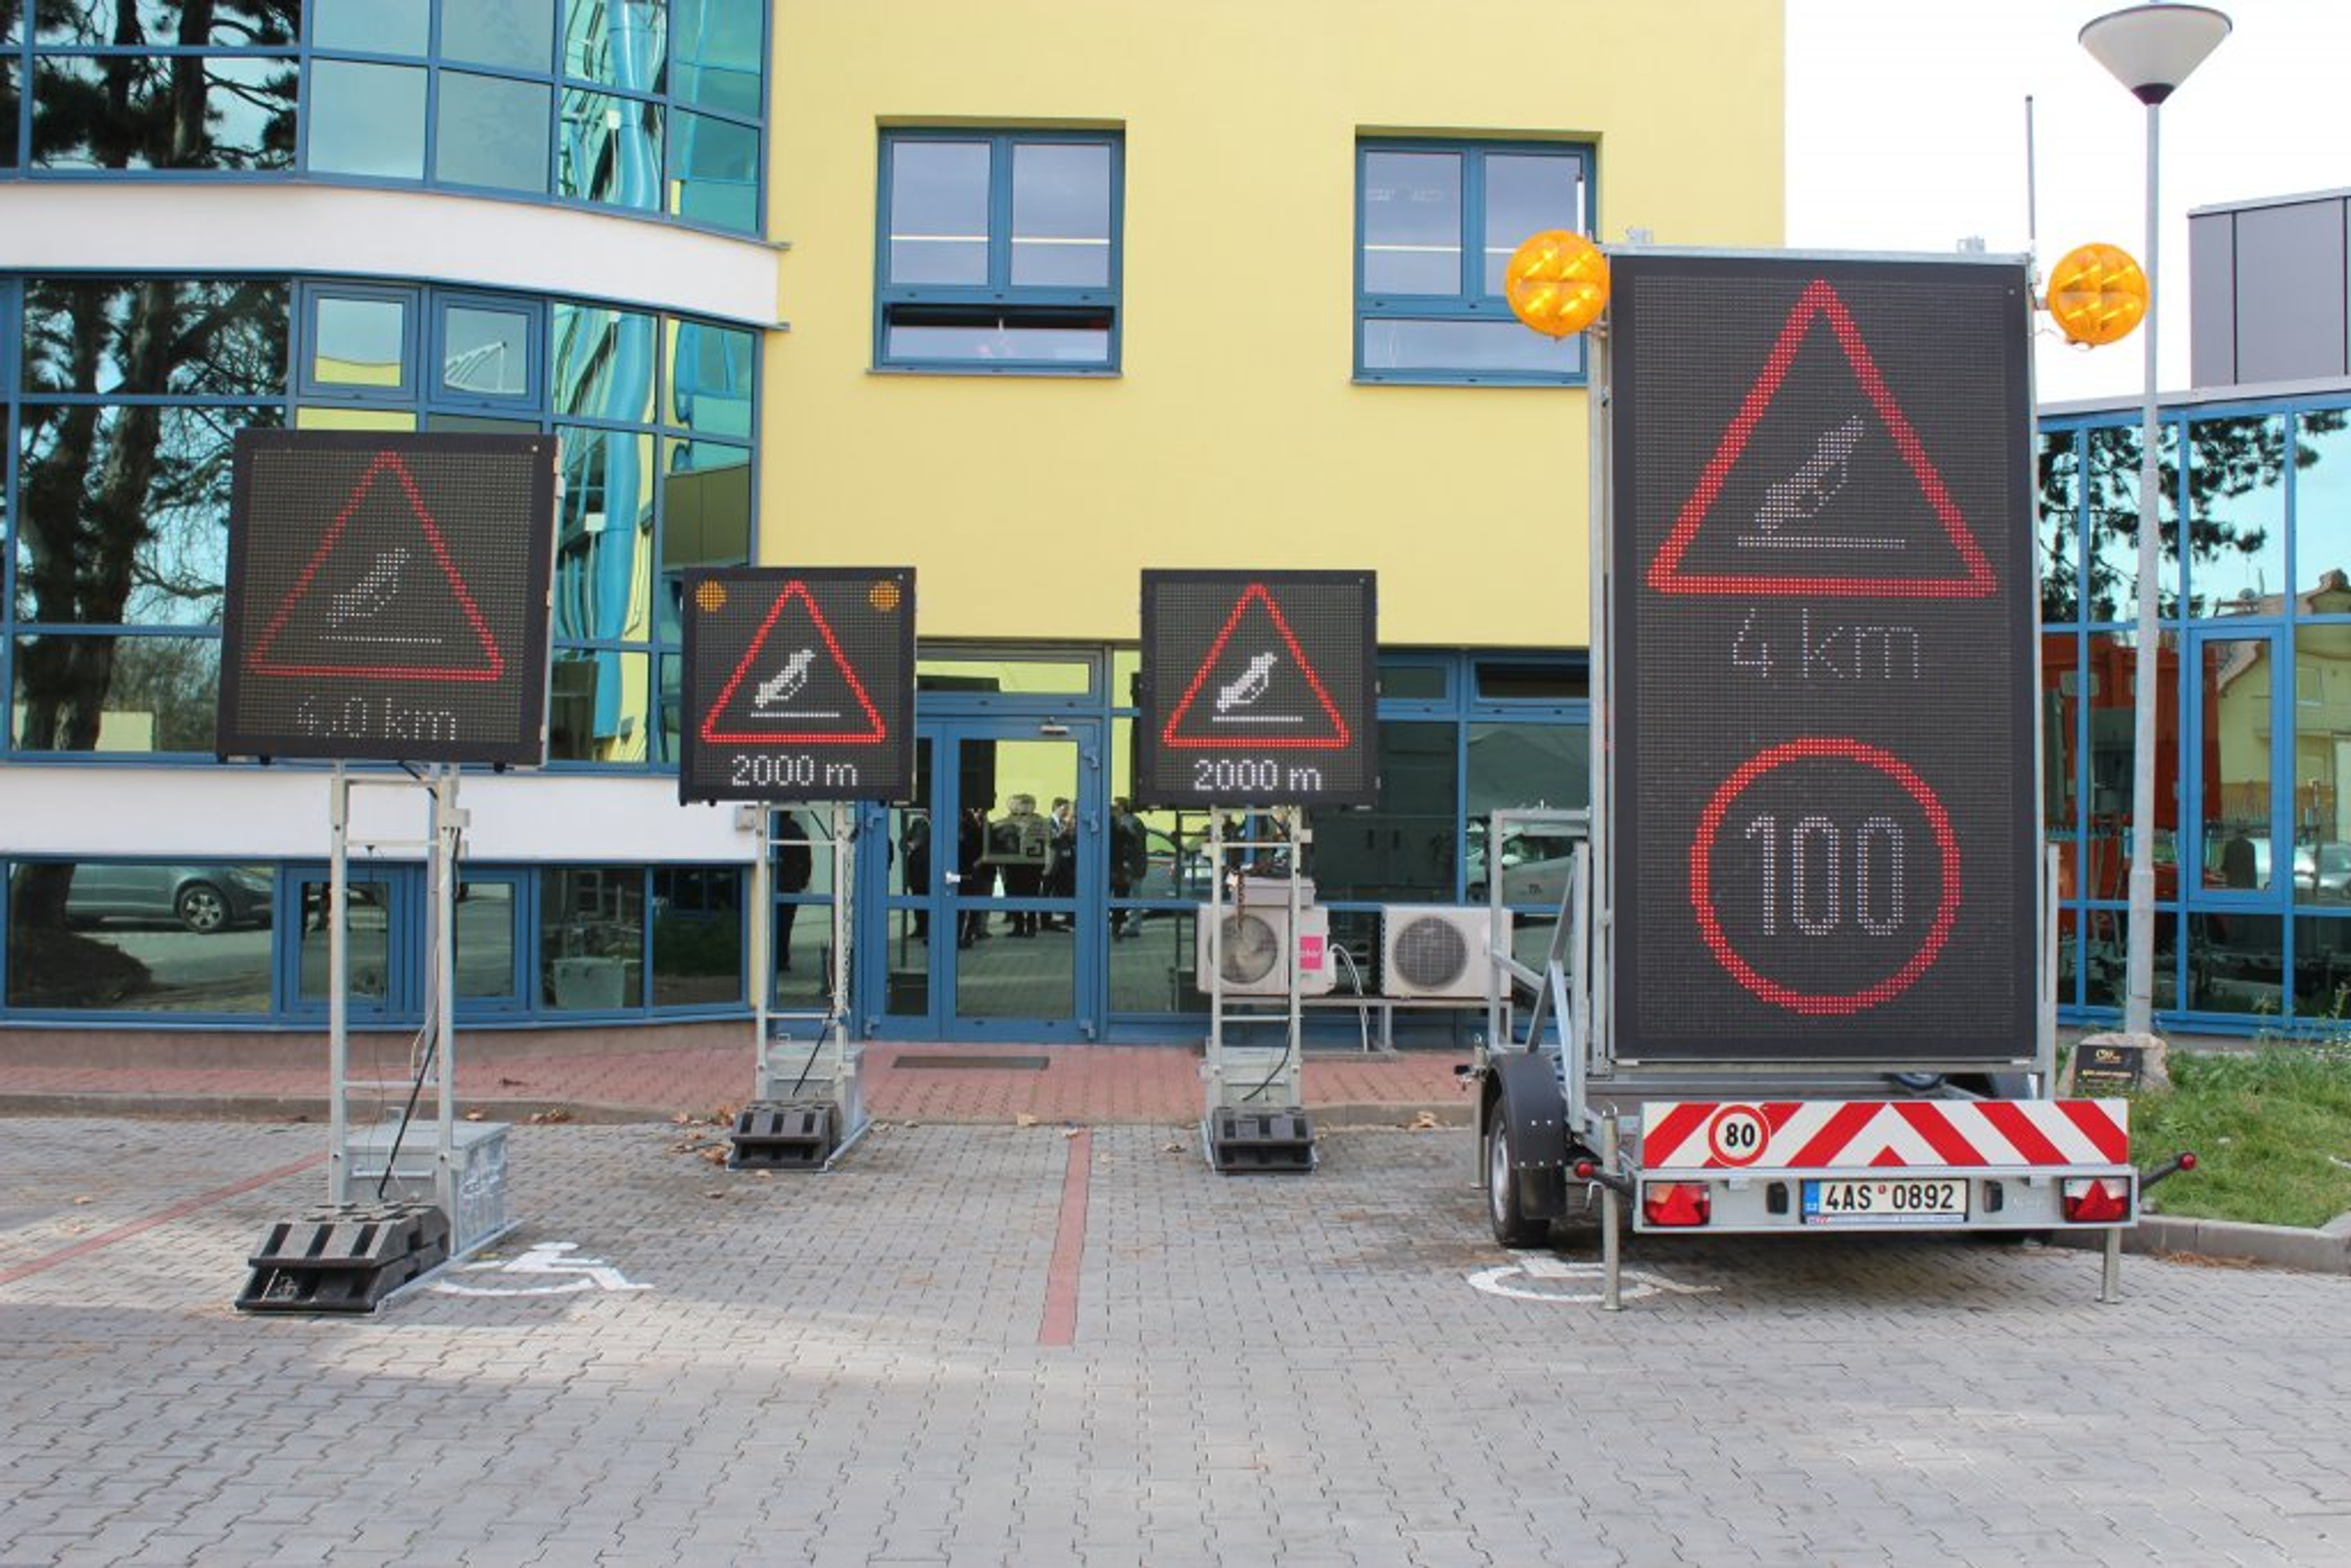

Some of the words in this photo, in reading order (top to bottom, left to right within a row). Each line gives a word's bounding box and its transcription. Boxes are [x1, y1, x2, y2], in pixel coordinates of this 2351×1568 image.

[1732, 607, 1773, 678] 4
[1802, 607, 1920, 679] km
[385, 697, 456, 740] km
[732, 754, 814, 786] 2000
[826, 763, 858, 786] m
[1193, 759, 1277, 790] 2000
[1289, 768, 1322, 791] m
[1745, 816, 1904, 935] 100
[1725, 1122, 1755, 1148] 80
[1893, 1184, 1953, 1210] 0892
